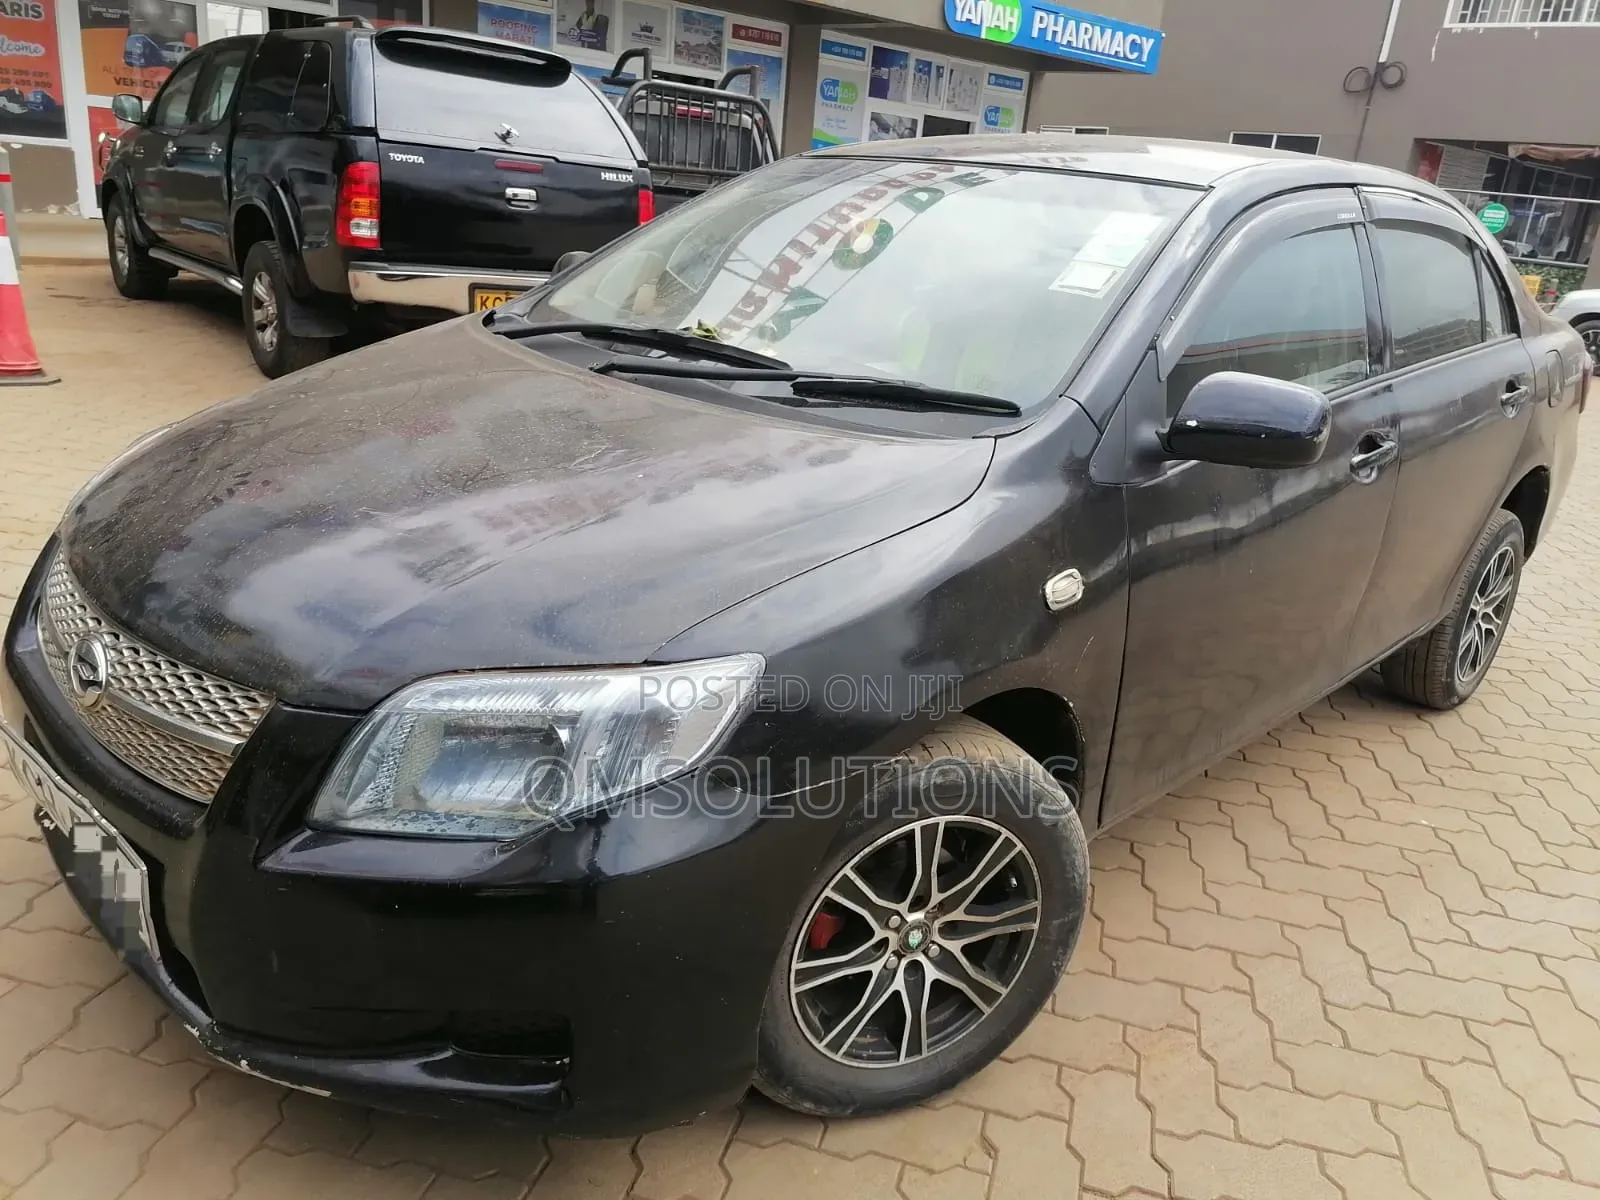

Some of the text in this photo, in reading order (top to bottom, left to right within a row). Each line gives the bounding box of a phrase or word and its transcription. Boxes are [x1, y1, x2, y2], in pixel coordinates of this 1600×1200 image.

[490, 18, 538, 33] ROOFING
[1031, 11, 1155, 62] PHARMACY
[388, 152, 425, 164] TOYOTA
[600, 171, 634, 183] HILUX
[479, 292, 516, 311] KC
